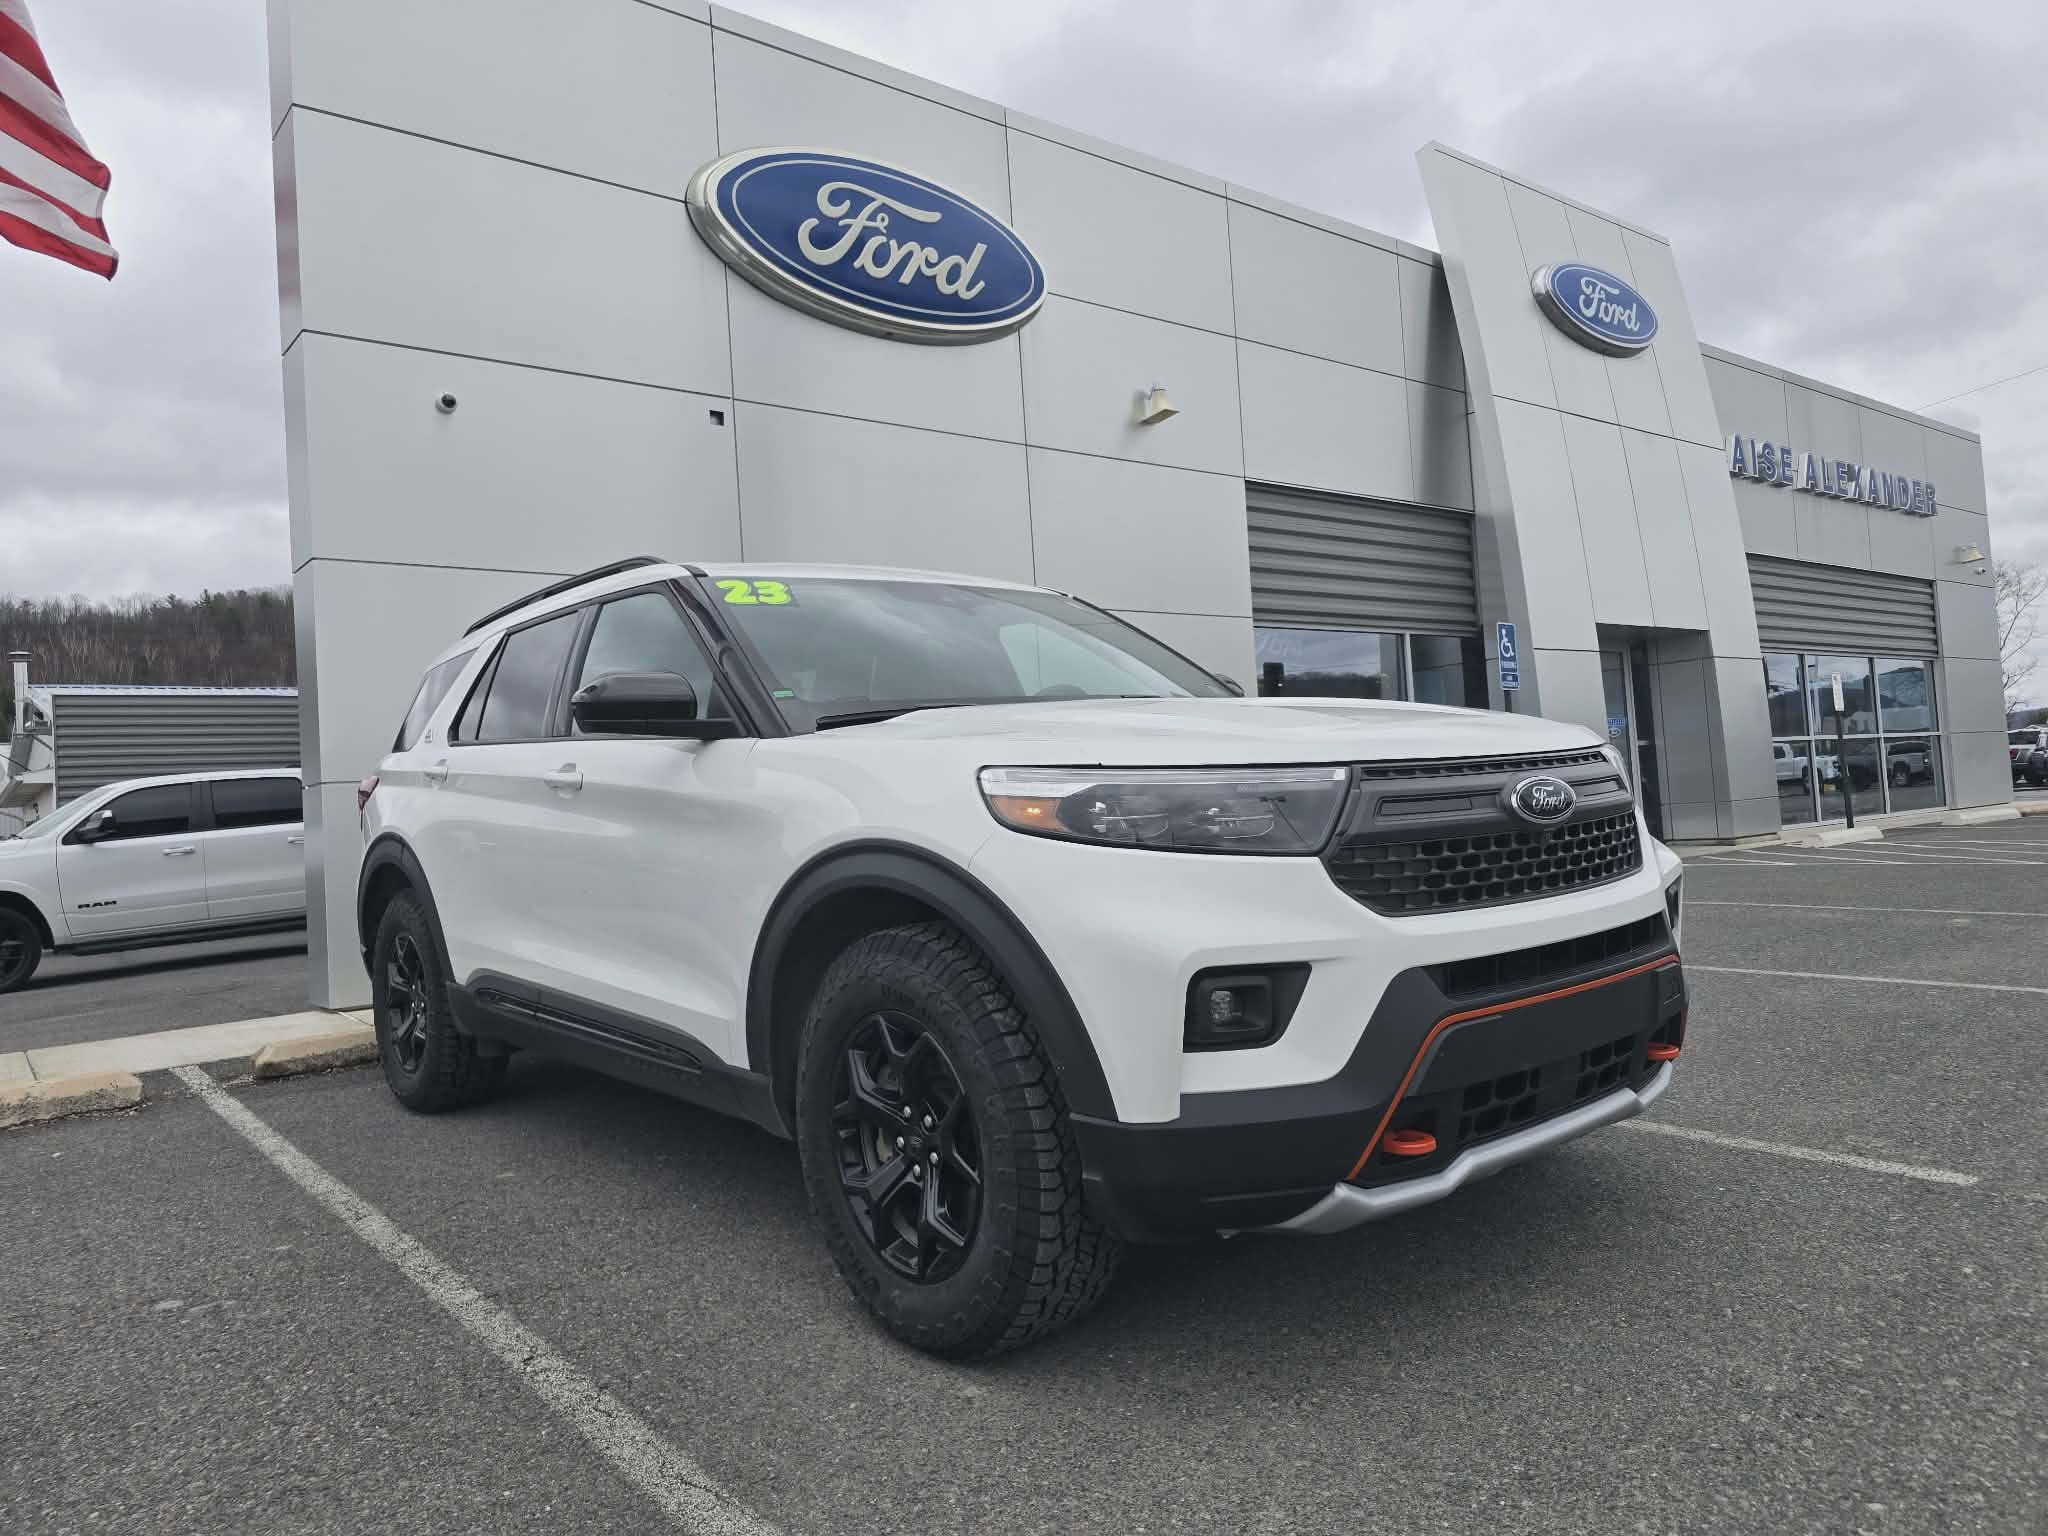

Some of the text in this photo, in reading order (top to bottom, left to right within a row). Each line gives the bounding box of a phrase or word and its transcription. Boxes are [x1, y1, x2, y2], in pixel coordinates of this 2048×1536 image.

[798, 181, 988, 300] Ford
[1579, 276, 1641, 332] Ford
[1798, 452, 1938, 516] ALEXANDER
[715, 579, 792, 605] 23
[1532, 785, 1567, 810] Ford
[78, 900, 117, 909] RAM
